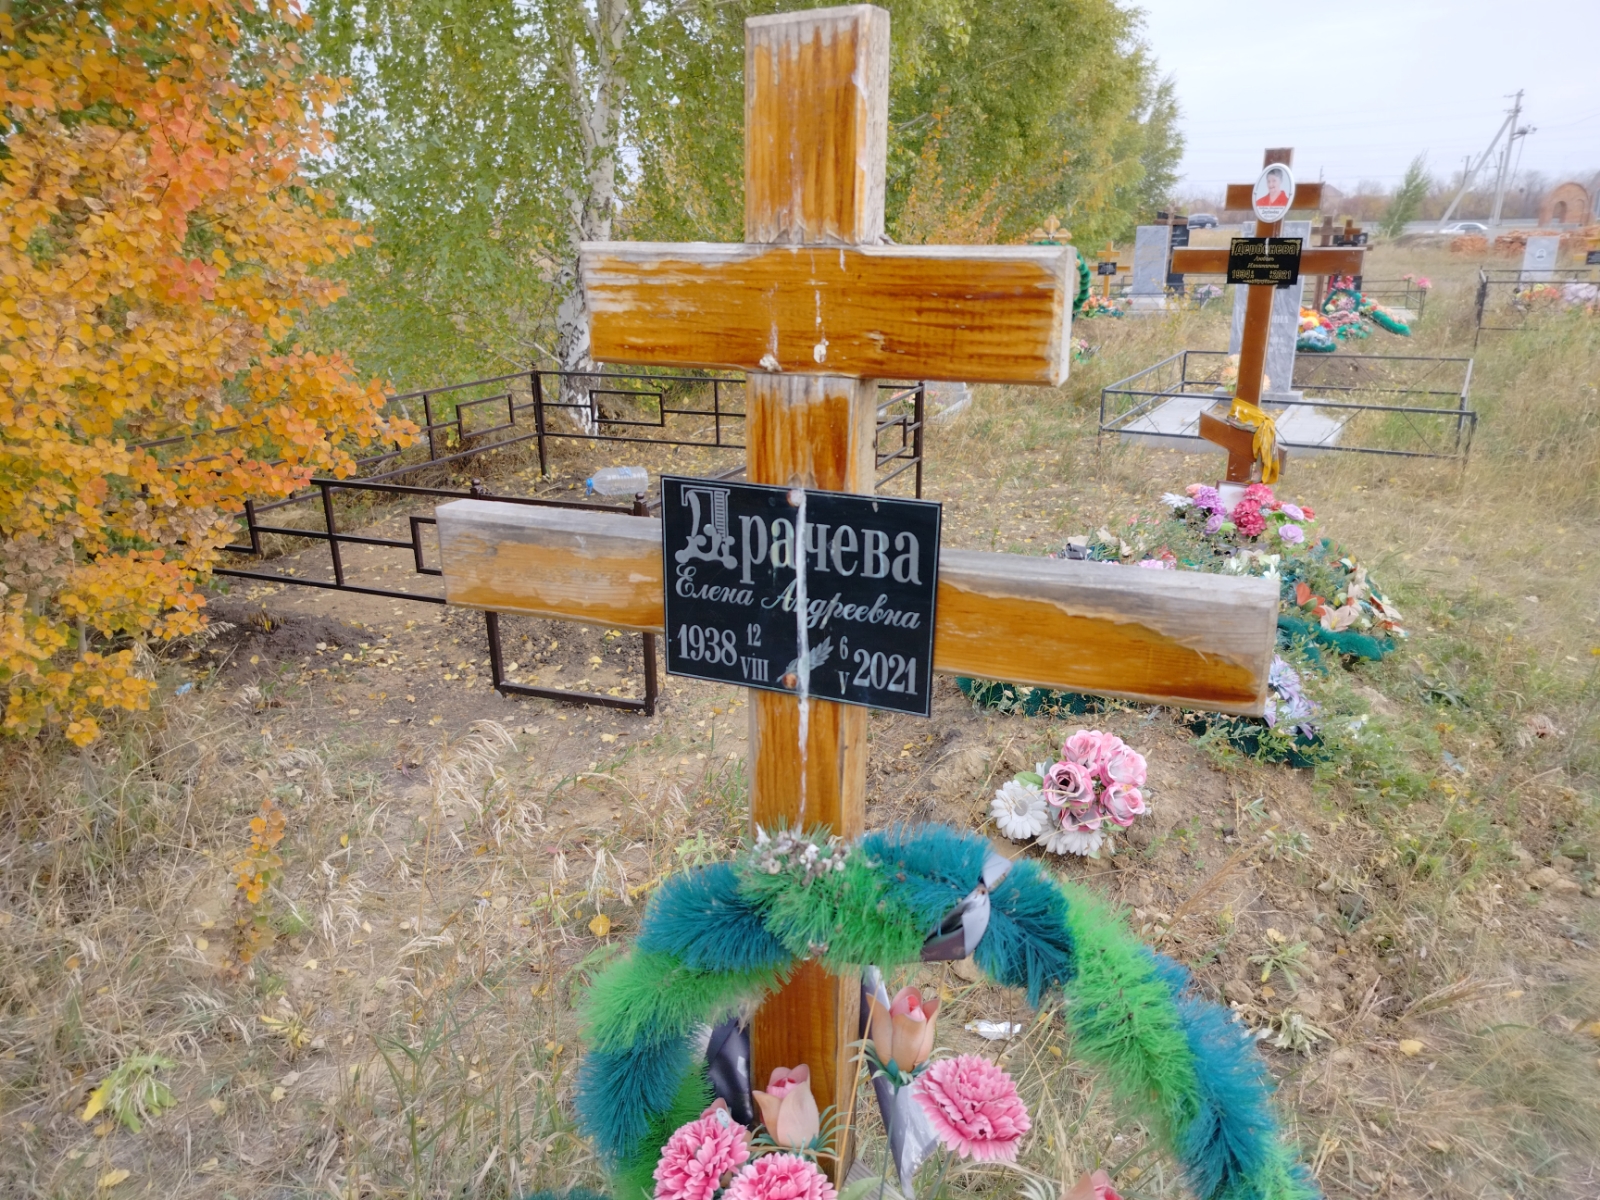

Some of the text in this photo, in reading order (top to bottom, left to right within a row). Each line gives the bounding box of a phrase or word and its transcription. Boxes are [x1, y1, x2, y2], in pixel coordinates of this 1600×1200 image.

[1272, 269, 1291, 280] 2021
[675, 484, 922, 586] Драчева
[675, 564, 754, 606] Елена
[677, 624, 918, 696] 1938 2021
[746, 623, 849, 660] 12 6
[740, 655, 850, 695] VIII V
